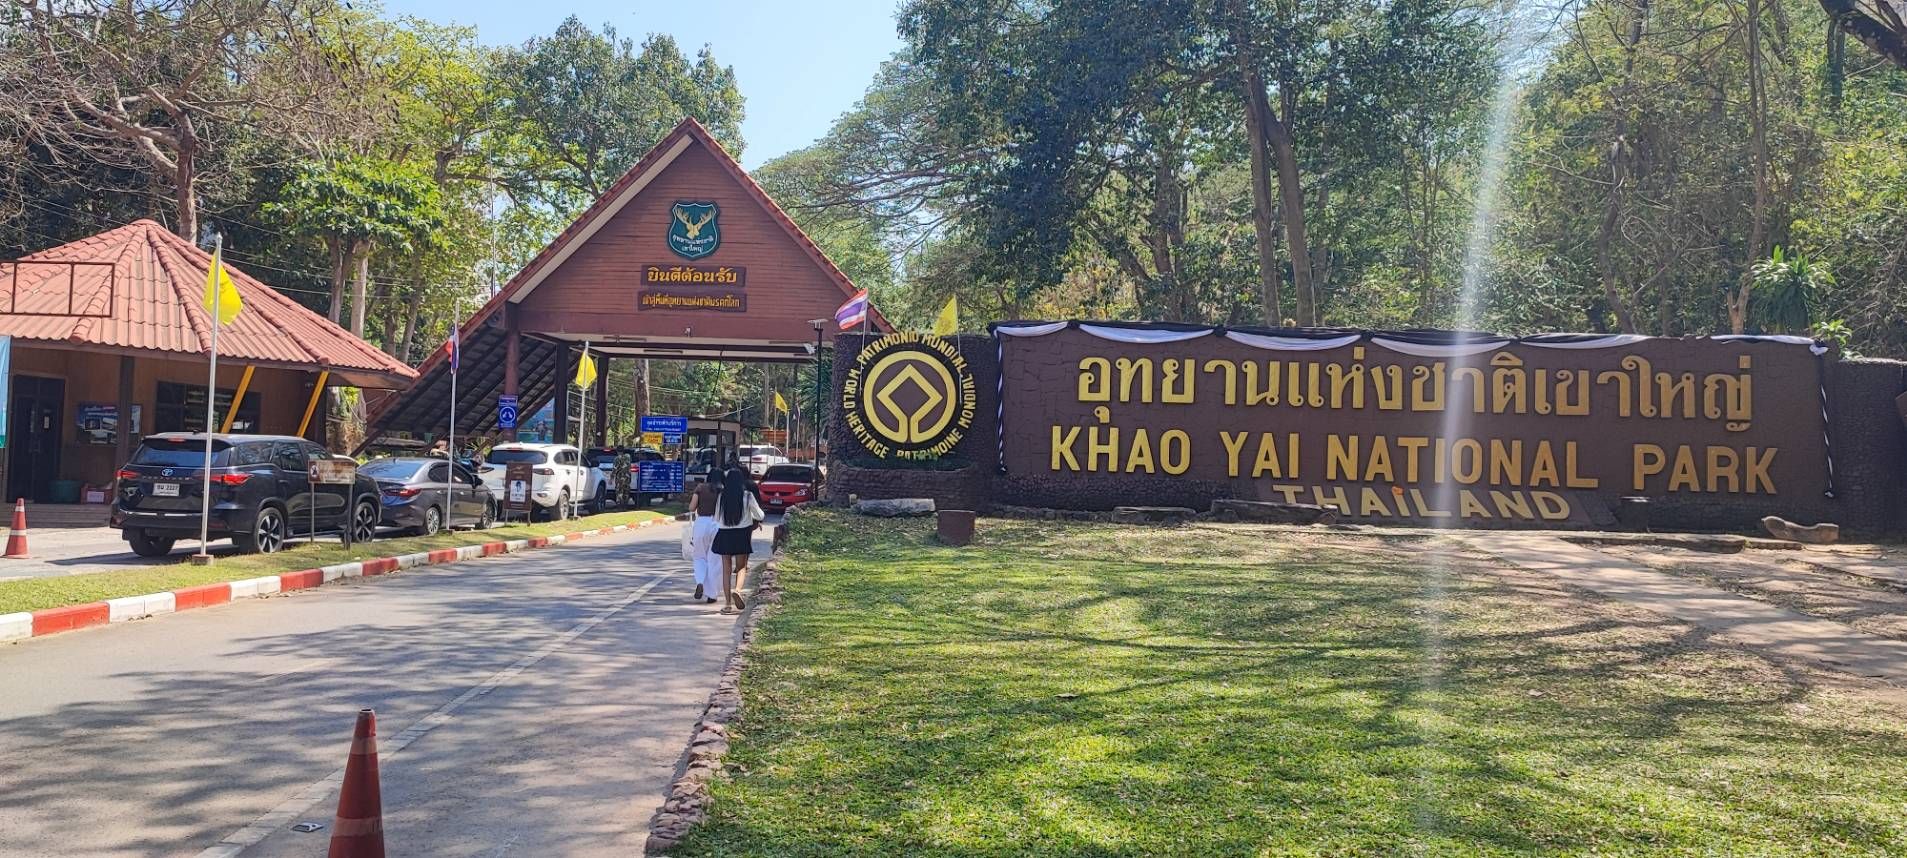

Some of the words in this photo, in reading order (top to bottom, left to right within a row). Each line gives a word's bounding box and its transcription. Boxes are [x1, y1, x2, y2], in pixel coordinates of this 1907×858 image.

[647, 266, 737, 283] ยินดีต้อนรับ
[856, 330, 919, 365] PATRIMONIO
[921, 333, 968, 374] MUNDIAL
[843, 368, 861, 409] WORLD
[958, 373, 977, 429] MONDIAL
[1078, 346, 1753, 432] อุทยานแห่งชาติเขาใหญ่
[846, 411, 890, 460] HERITAGE
[1051, 425, 1192, 475] KHAO
[1220, 431, 1300, 478] YAI
[1326, 434, 1599, 489] NATIONAL
[1633, 443, 1778, 494] PARK
[1273, 484, 1571, 520] THAILAND
